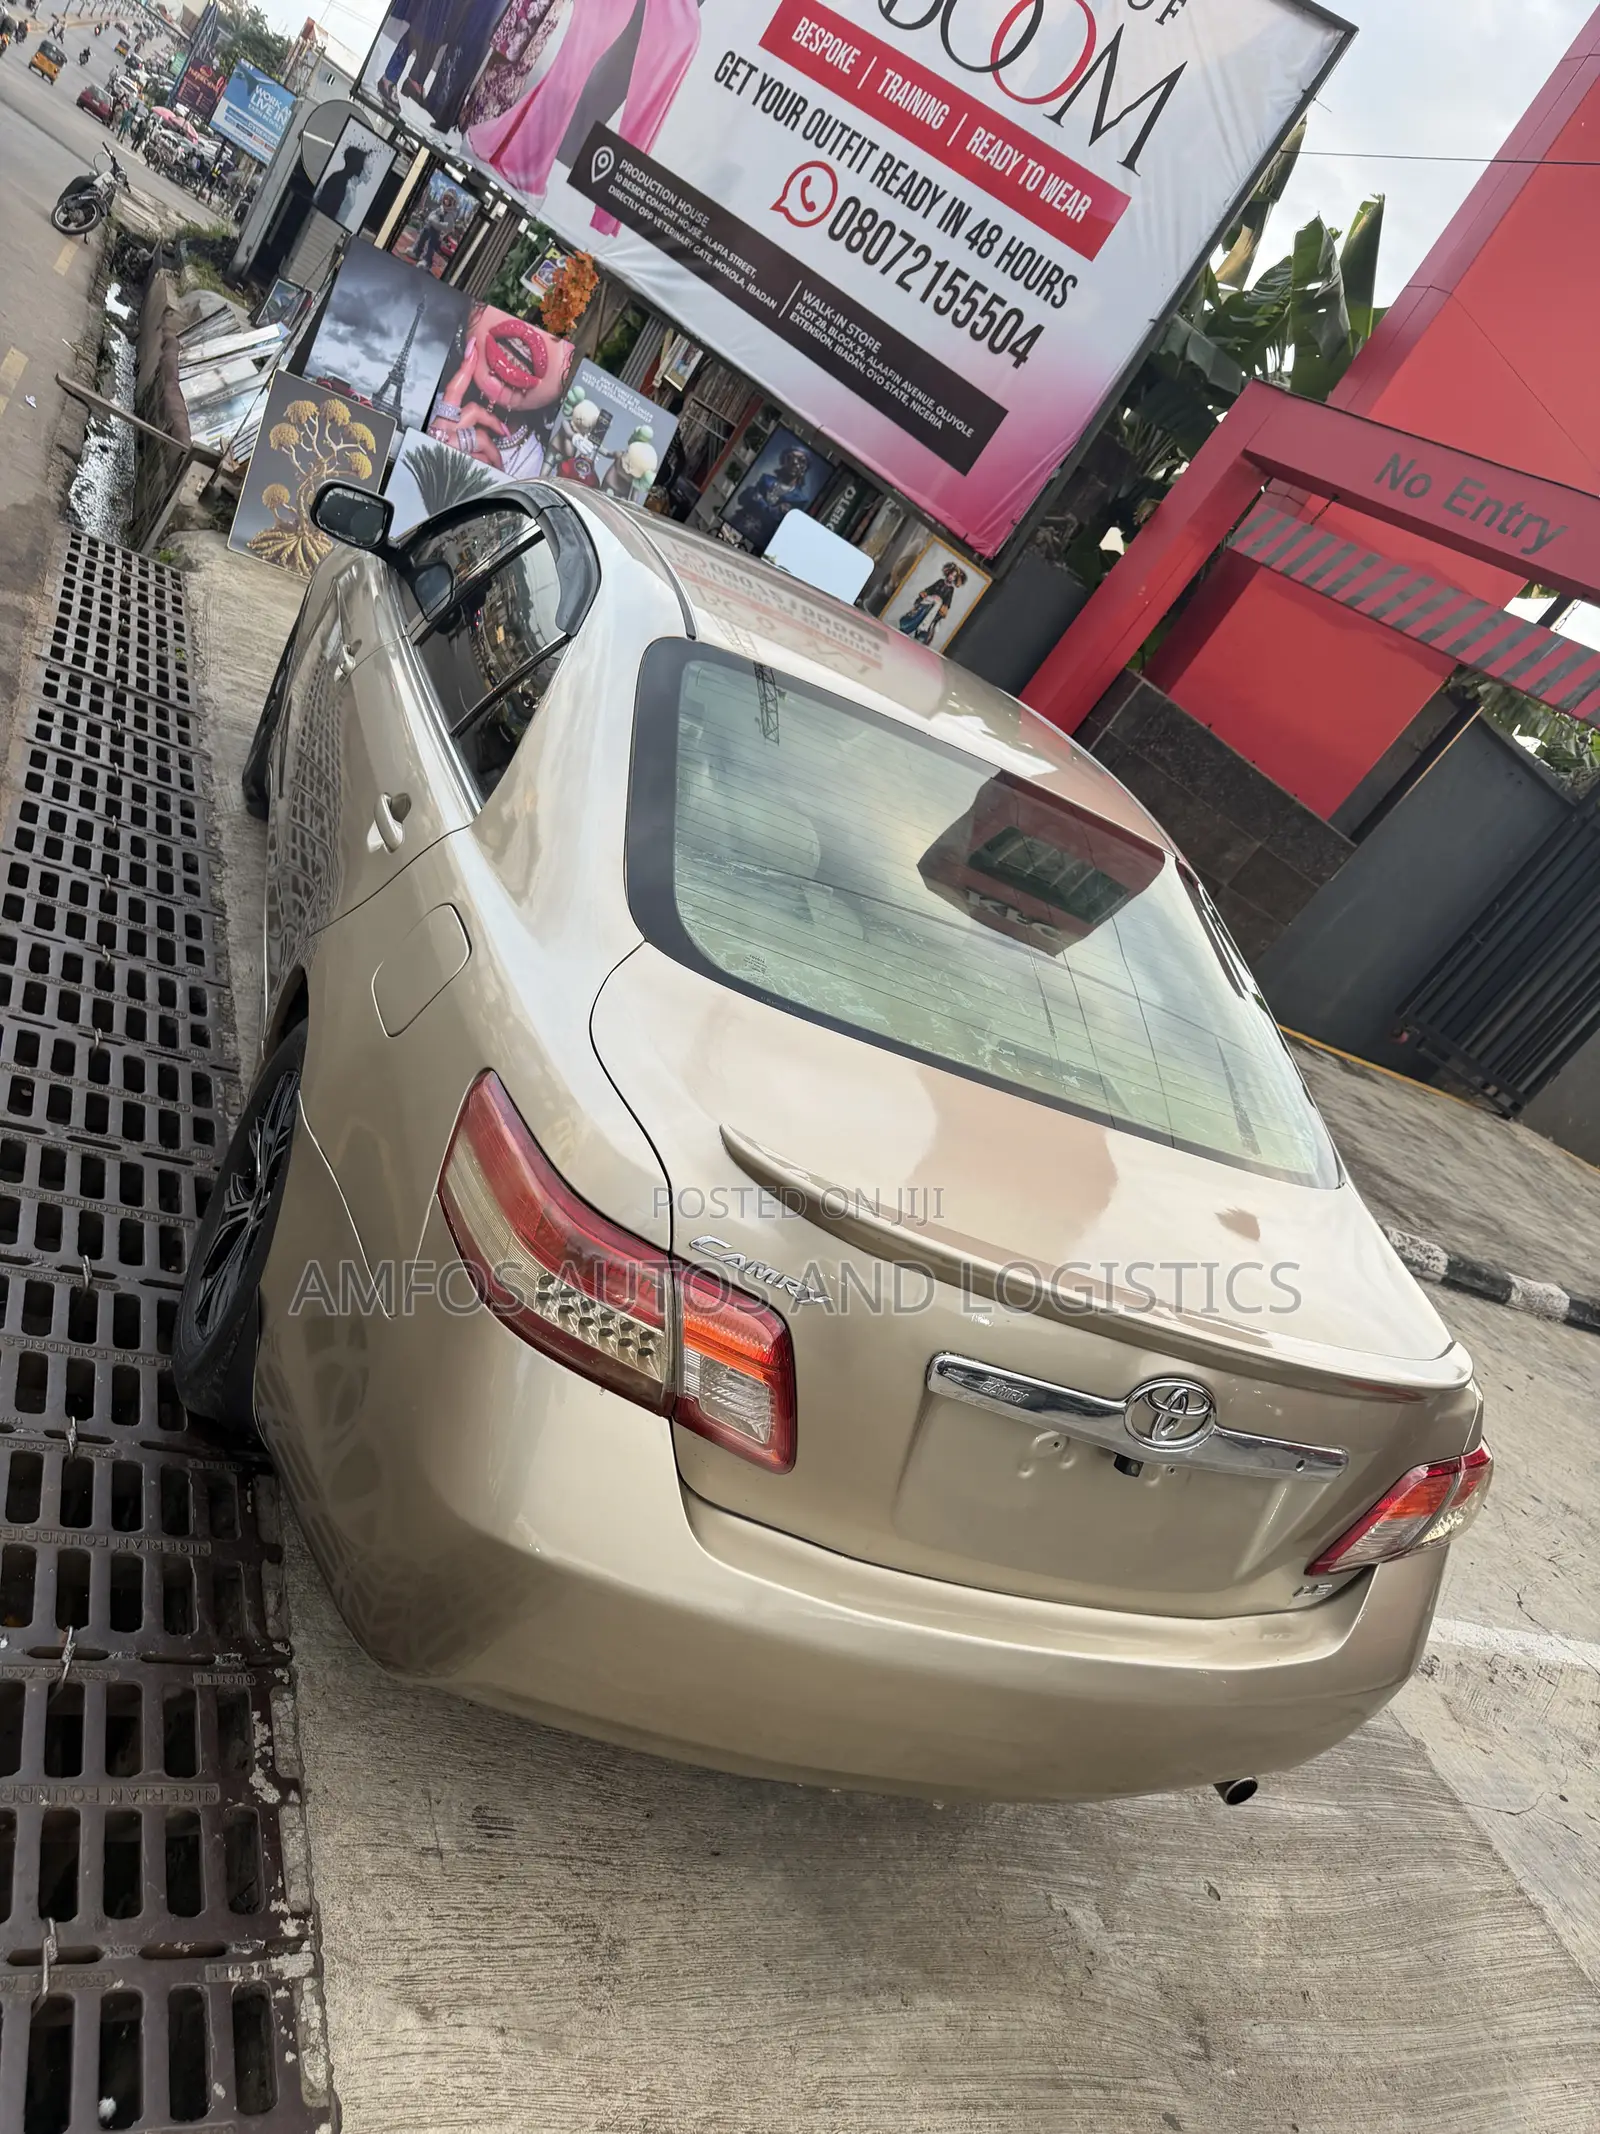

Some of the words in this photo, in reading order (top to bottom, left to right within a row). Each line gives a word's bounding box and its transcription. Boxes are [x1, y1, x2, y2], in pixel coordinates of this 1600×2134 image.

[792, 16, 860, 73] BESPOKE
[249, 92, 275, 117] LIVE
[253, 84, 282, 109] WORK
[877, 68, 949, 128] TRAINING
[619, 159, 676, 204] PRODUCTION
[676, 198, 709, 227] HOUSE
[714, 51, 758, 95] GET
[752, 72, 807, 130] YOUR
[802, 108, 879, 173] OUTFIT
[869, 152, 947, 218] READY
[936, 197, 971, 237] IN
[964, 218, 1002, 258] 48
[994, 236, 1077, 308] HOURS
[966, 126, 1024, 175] READY
[1018, 158, 1044, 190] TO
[1039, 173, 1091, 222] WEAR
[608, 185, 639, 209] DIRECTLY
[638, 206, 653, 219] OPP
[653, 216, 693, 247] VETERINARY
[693, 245, 712, 264] GATE,
[713, 259, 744, 288] MOKOLA,
[746, 283, 776, 308] IBADAN
[614, 172, 622, 182] 10
[622, 178, 646, 199] BESIDE
[645, 194, 678, 220] COMFORT
[702, 235, 727, 257] ALAFIA
[728, 253, 756, 278] STREET,
[802, 289, 847, 328] WALK-IN
[846, 323, 881, 352] STORE
[828, 196, 1044, 368] 08072155504
[789, 311, 832, 349] EXTENSION,
[833, 344, 865, 372] IBADAN,
[866, 368, 884, 384] OYO
[883, 381, 908, 405] STATE,
[910, 400, 941, 428] NIGERIA
[795, 302, 816, 320] PLOT
[827, 326, 855, 350] BLOCK
[866, 356, 902, 384] ALAAFIN
[901, 381, 934, 410] AVENUE,
[936, 406, 973, 437] OLUYOLE
[1373, 453, 1432, 499] No
[1442, 476, 1568, 555] Entry
[689, 1234, 833, 1304] CAMRY
[109, 1784, 216, 1803] NIGERIAN
